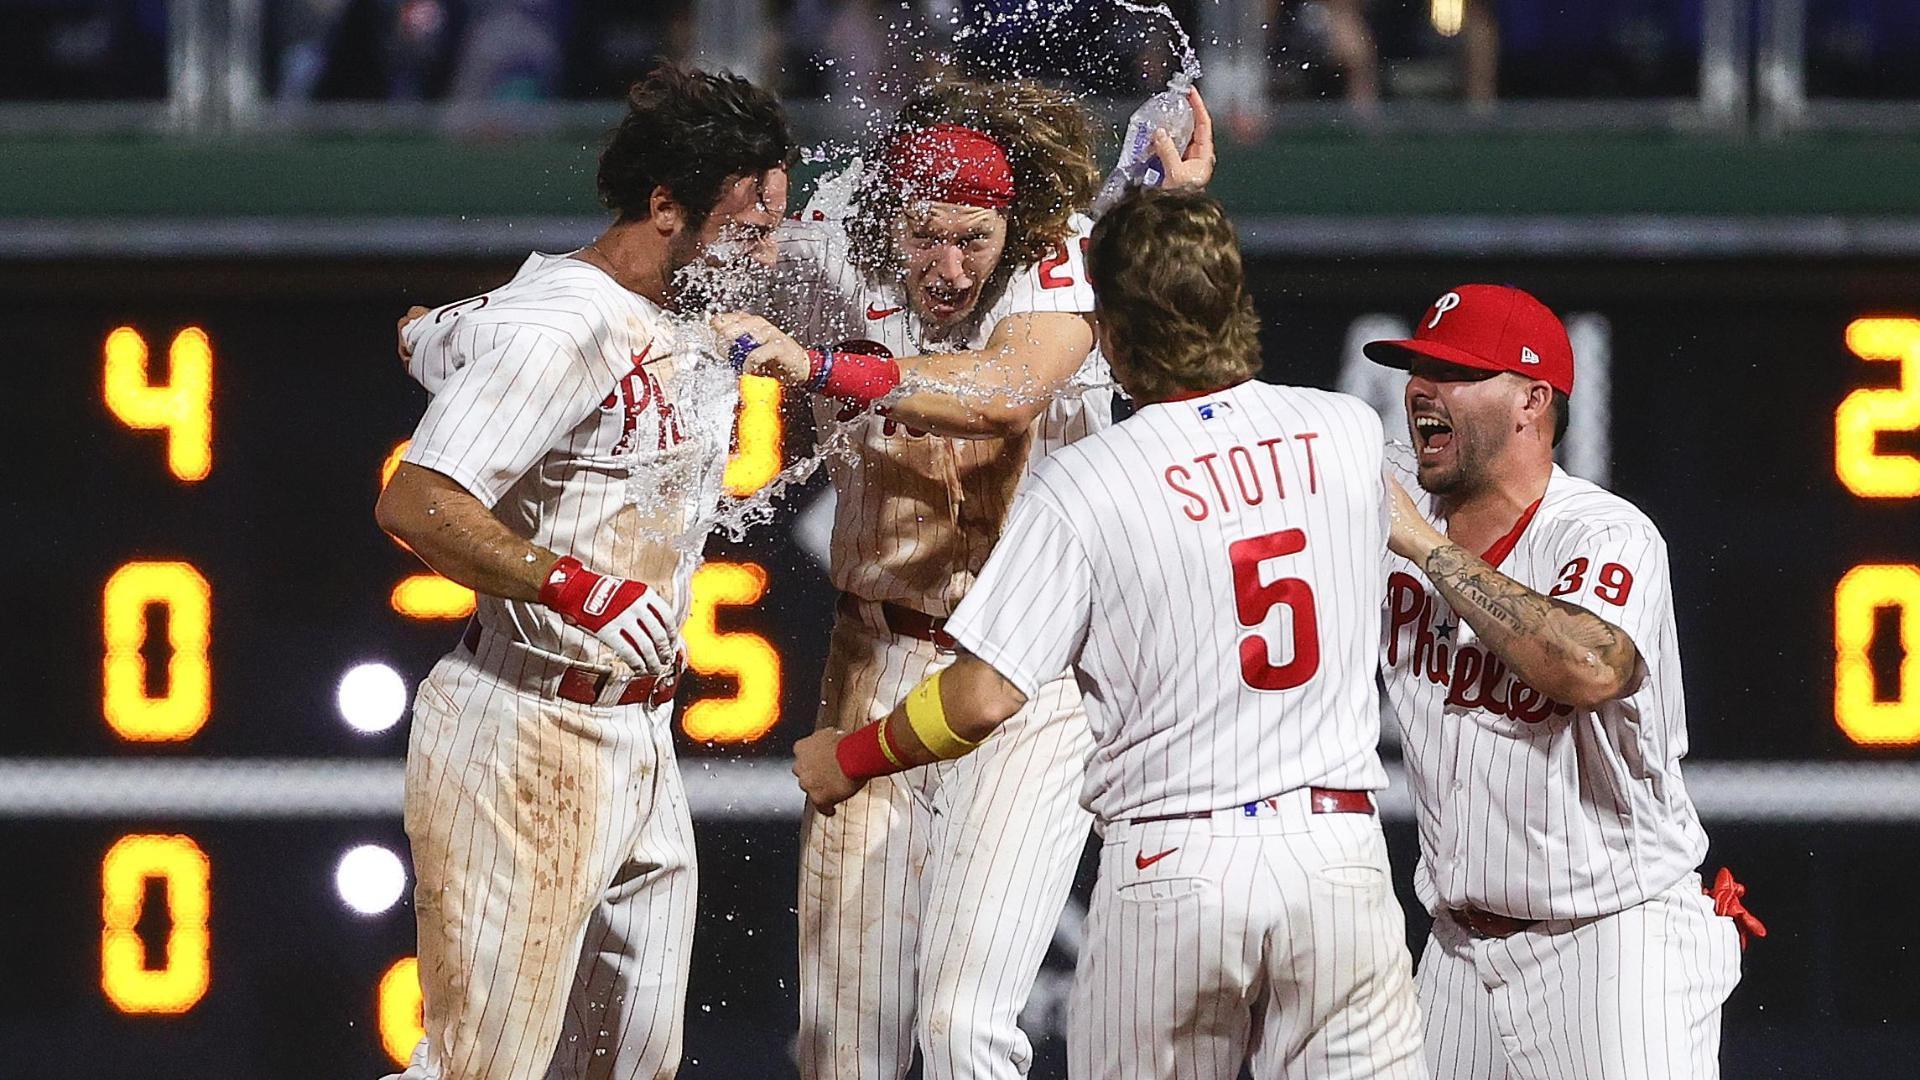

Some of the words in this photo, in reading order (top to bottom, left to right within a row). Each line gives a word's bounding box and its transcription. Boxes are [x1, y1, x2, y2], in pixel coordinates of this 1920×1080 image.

[1038, 237, 1093, 289] 2
[1428, 291, 1460, 329] P
[103, 326, 213, 481] 4
[1164, 432, 1319, 522] STOTT
[1228, 527, 1321, 690] 5
[1551, 557, 1634, 607] 39
[103, 561, 211, 742] 0
[101, 834, 210, 1014] 0
